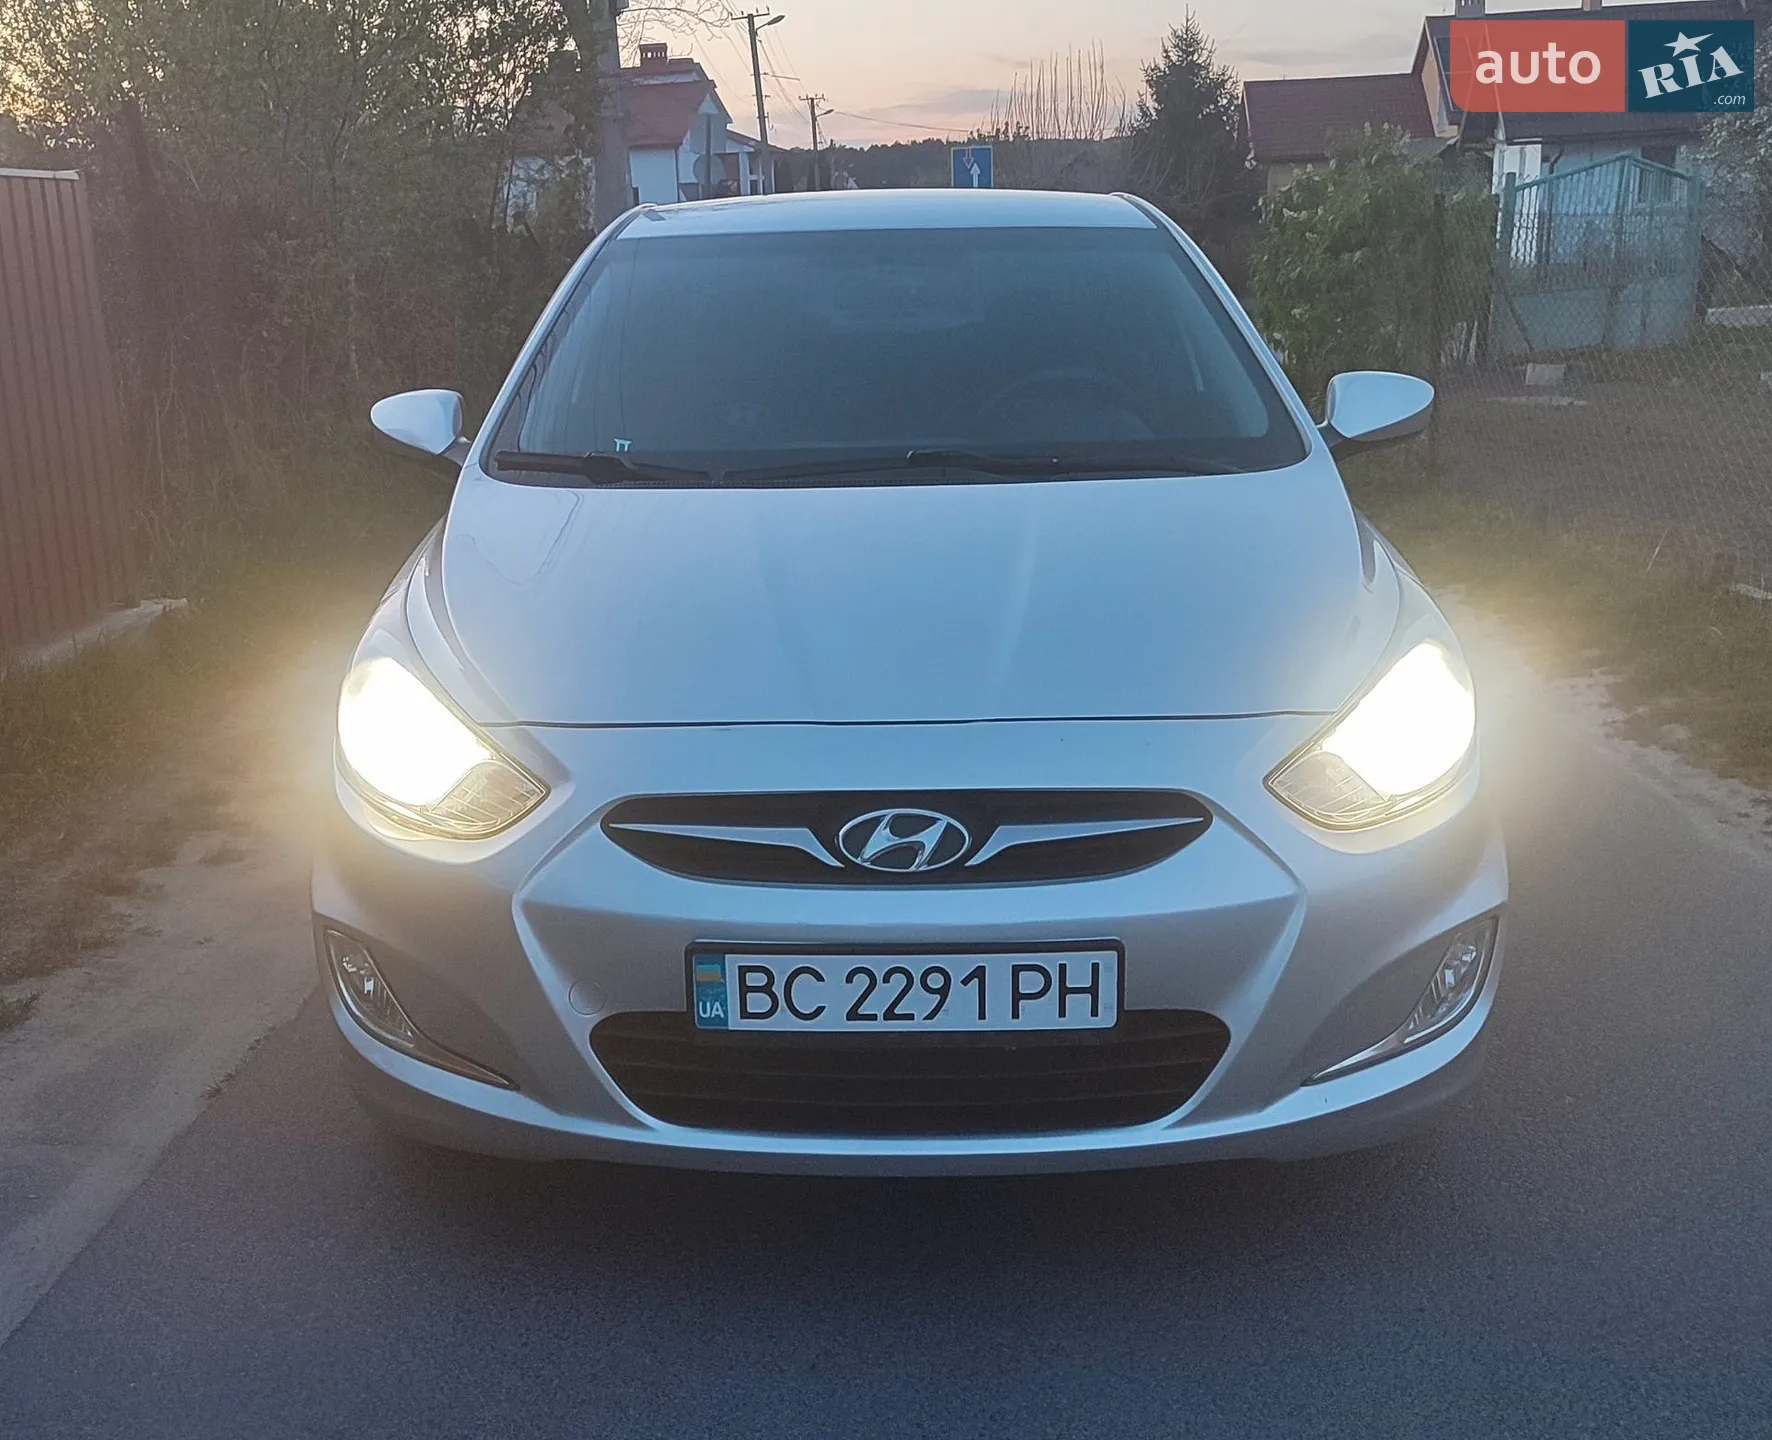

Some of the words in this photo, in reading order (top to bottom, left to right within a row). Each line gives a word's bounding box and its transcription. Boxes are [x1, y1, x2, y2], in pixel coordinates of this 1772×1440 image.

[699, 1002, 724, 1019] UA
[737, 965, 827, 1020] BC
[845, 965, 987, 1021] 2291
[1011, 962, 1100, 1019] PH
